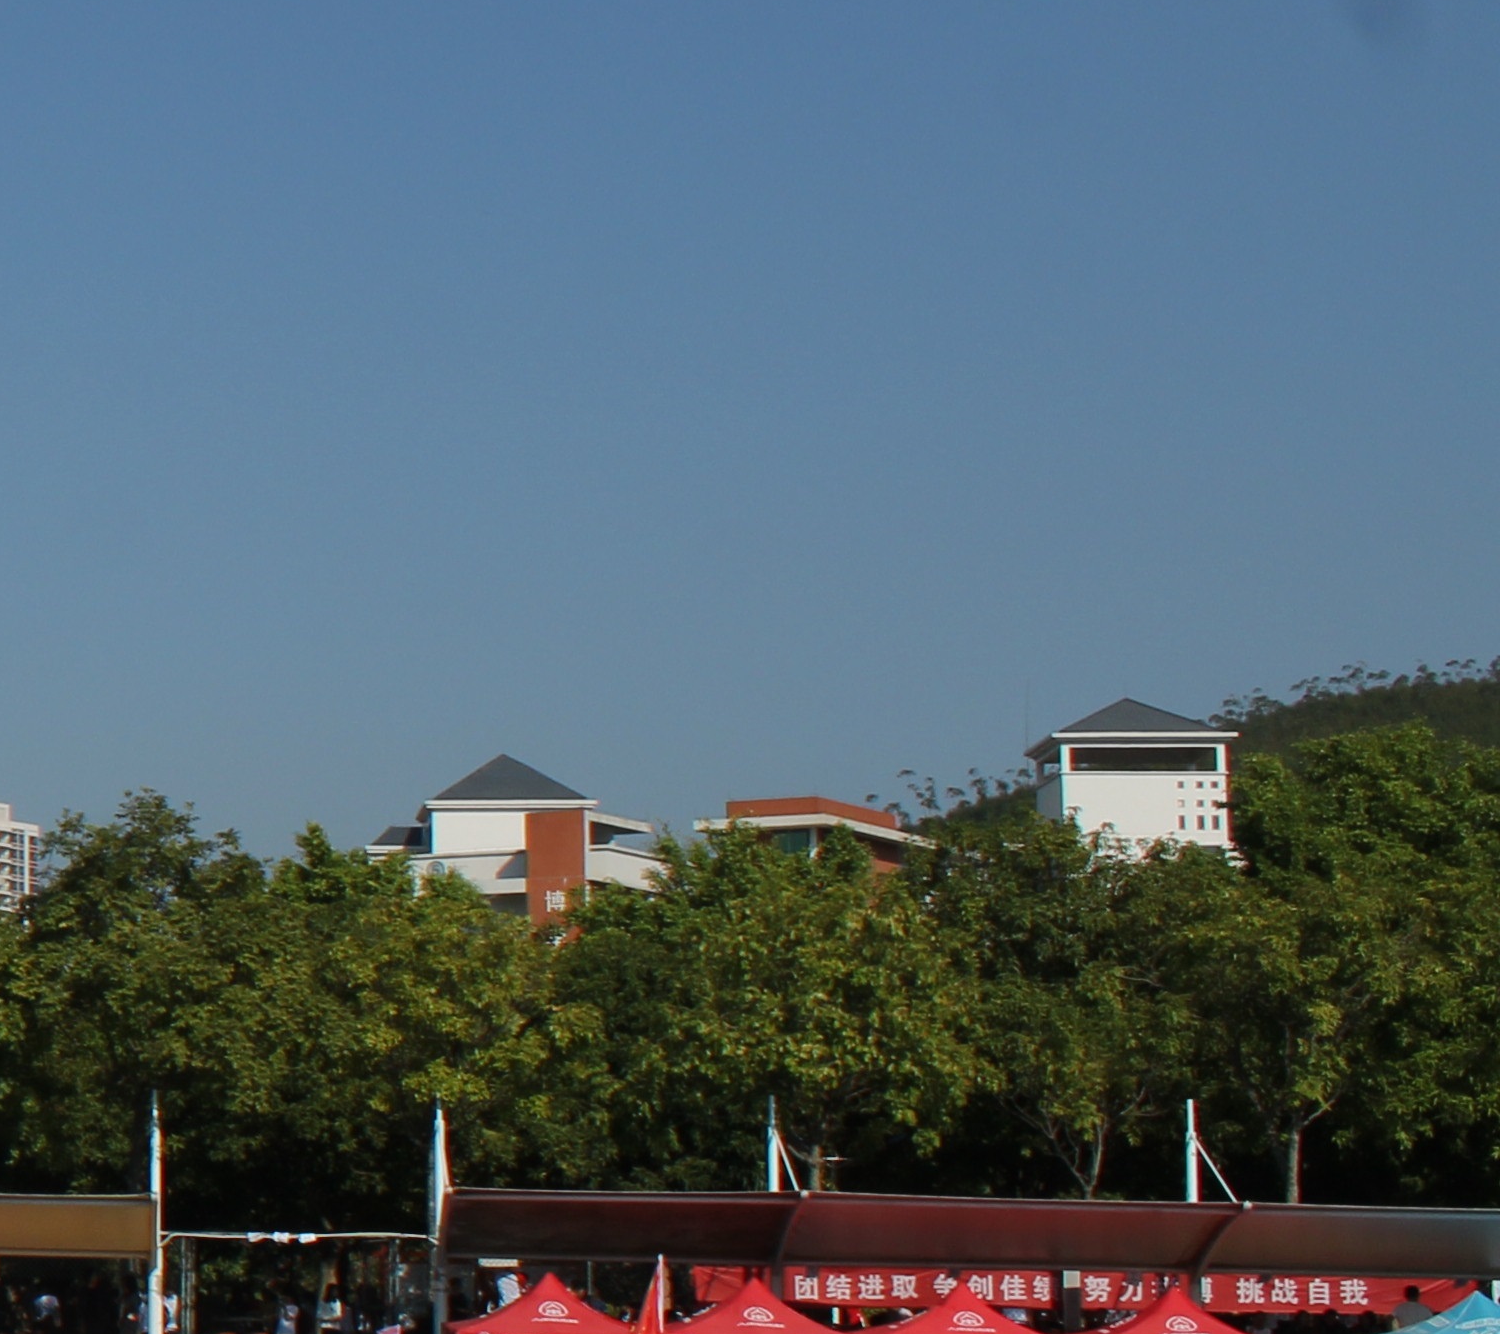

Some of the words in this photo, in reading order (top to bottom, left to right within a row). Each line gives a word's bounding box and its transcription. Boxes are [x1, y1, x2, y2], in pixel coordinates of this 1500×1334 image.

[794, 1274, 918, 1300] 团结进取
[1236, 1277, 1370, 1306] 挑战自我
